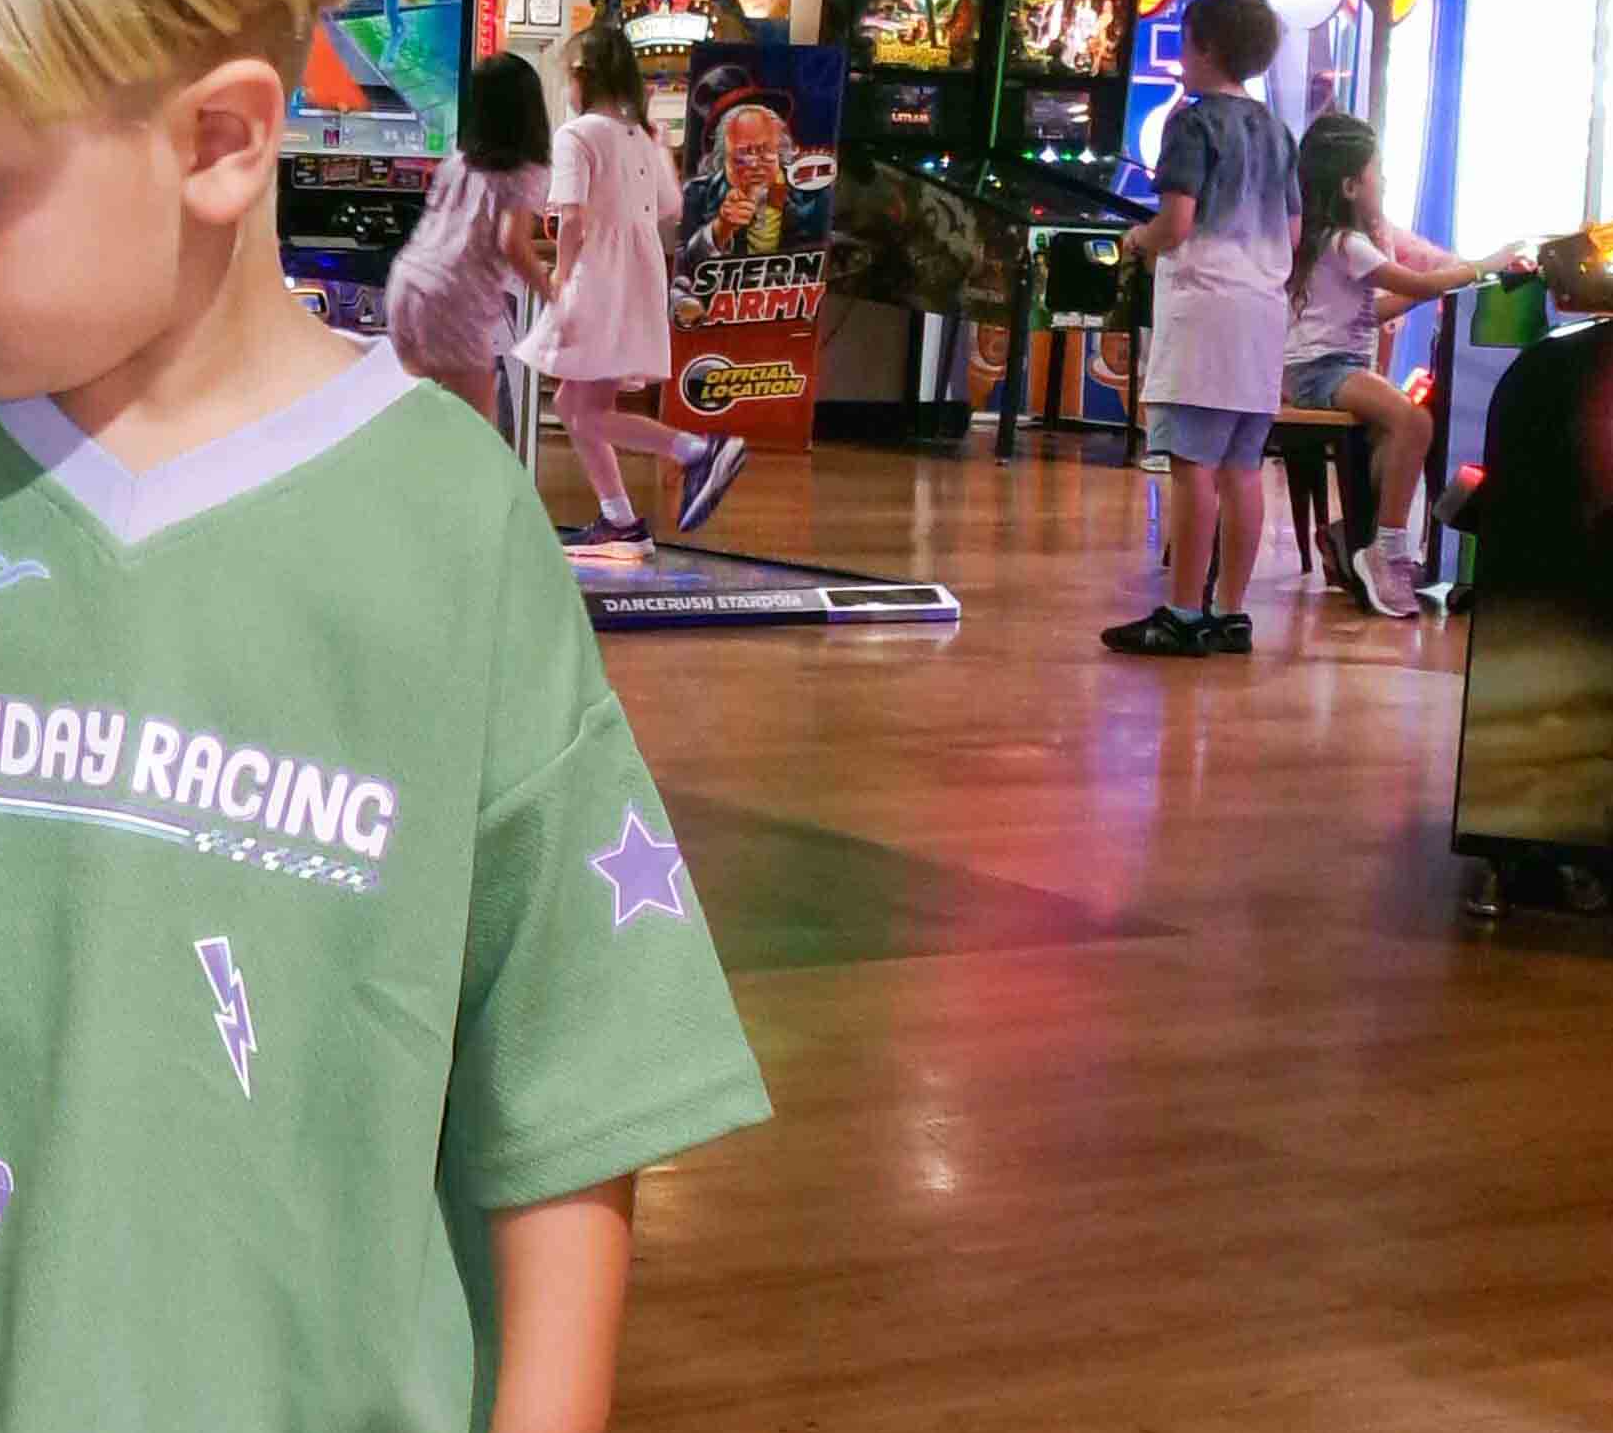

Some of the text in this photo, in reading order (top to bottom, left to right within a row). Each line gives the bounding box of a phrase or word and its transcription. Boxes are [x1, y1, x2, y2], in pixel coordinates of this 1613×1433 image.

[691, 251, 826, 295] STERN
[706, 284, 827, 325] ARMY
[701, 378, 803, 399] LOCATION
[705, 365, 792, 384] OFFICIAL
[602, 593, 804, 612] DANCERUSH STARDOM
[130, 714, 396, 859] RACING
